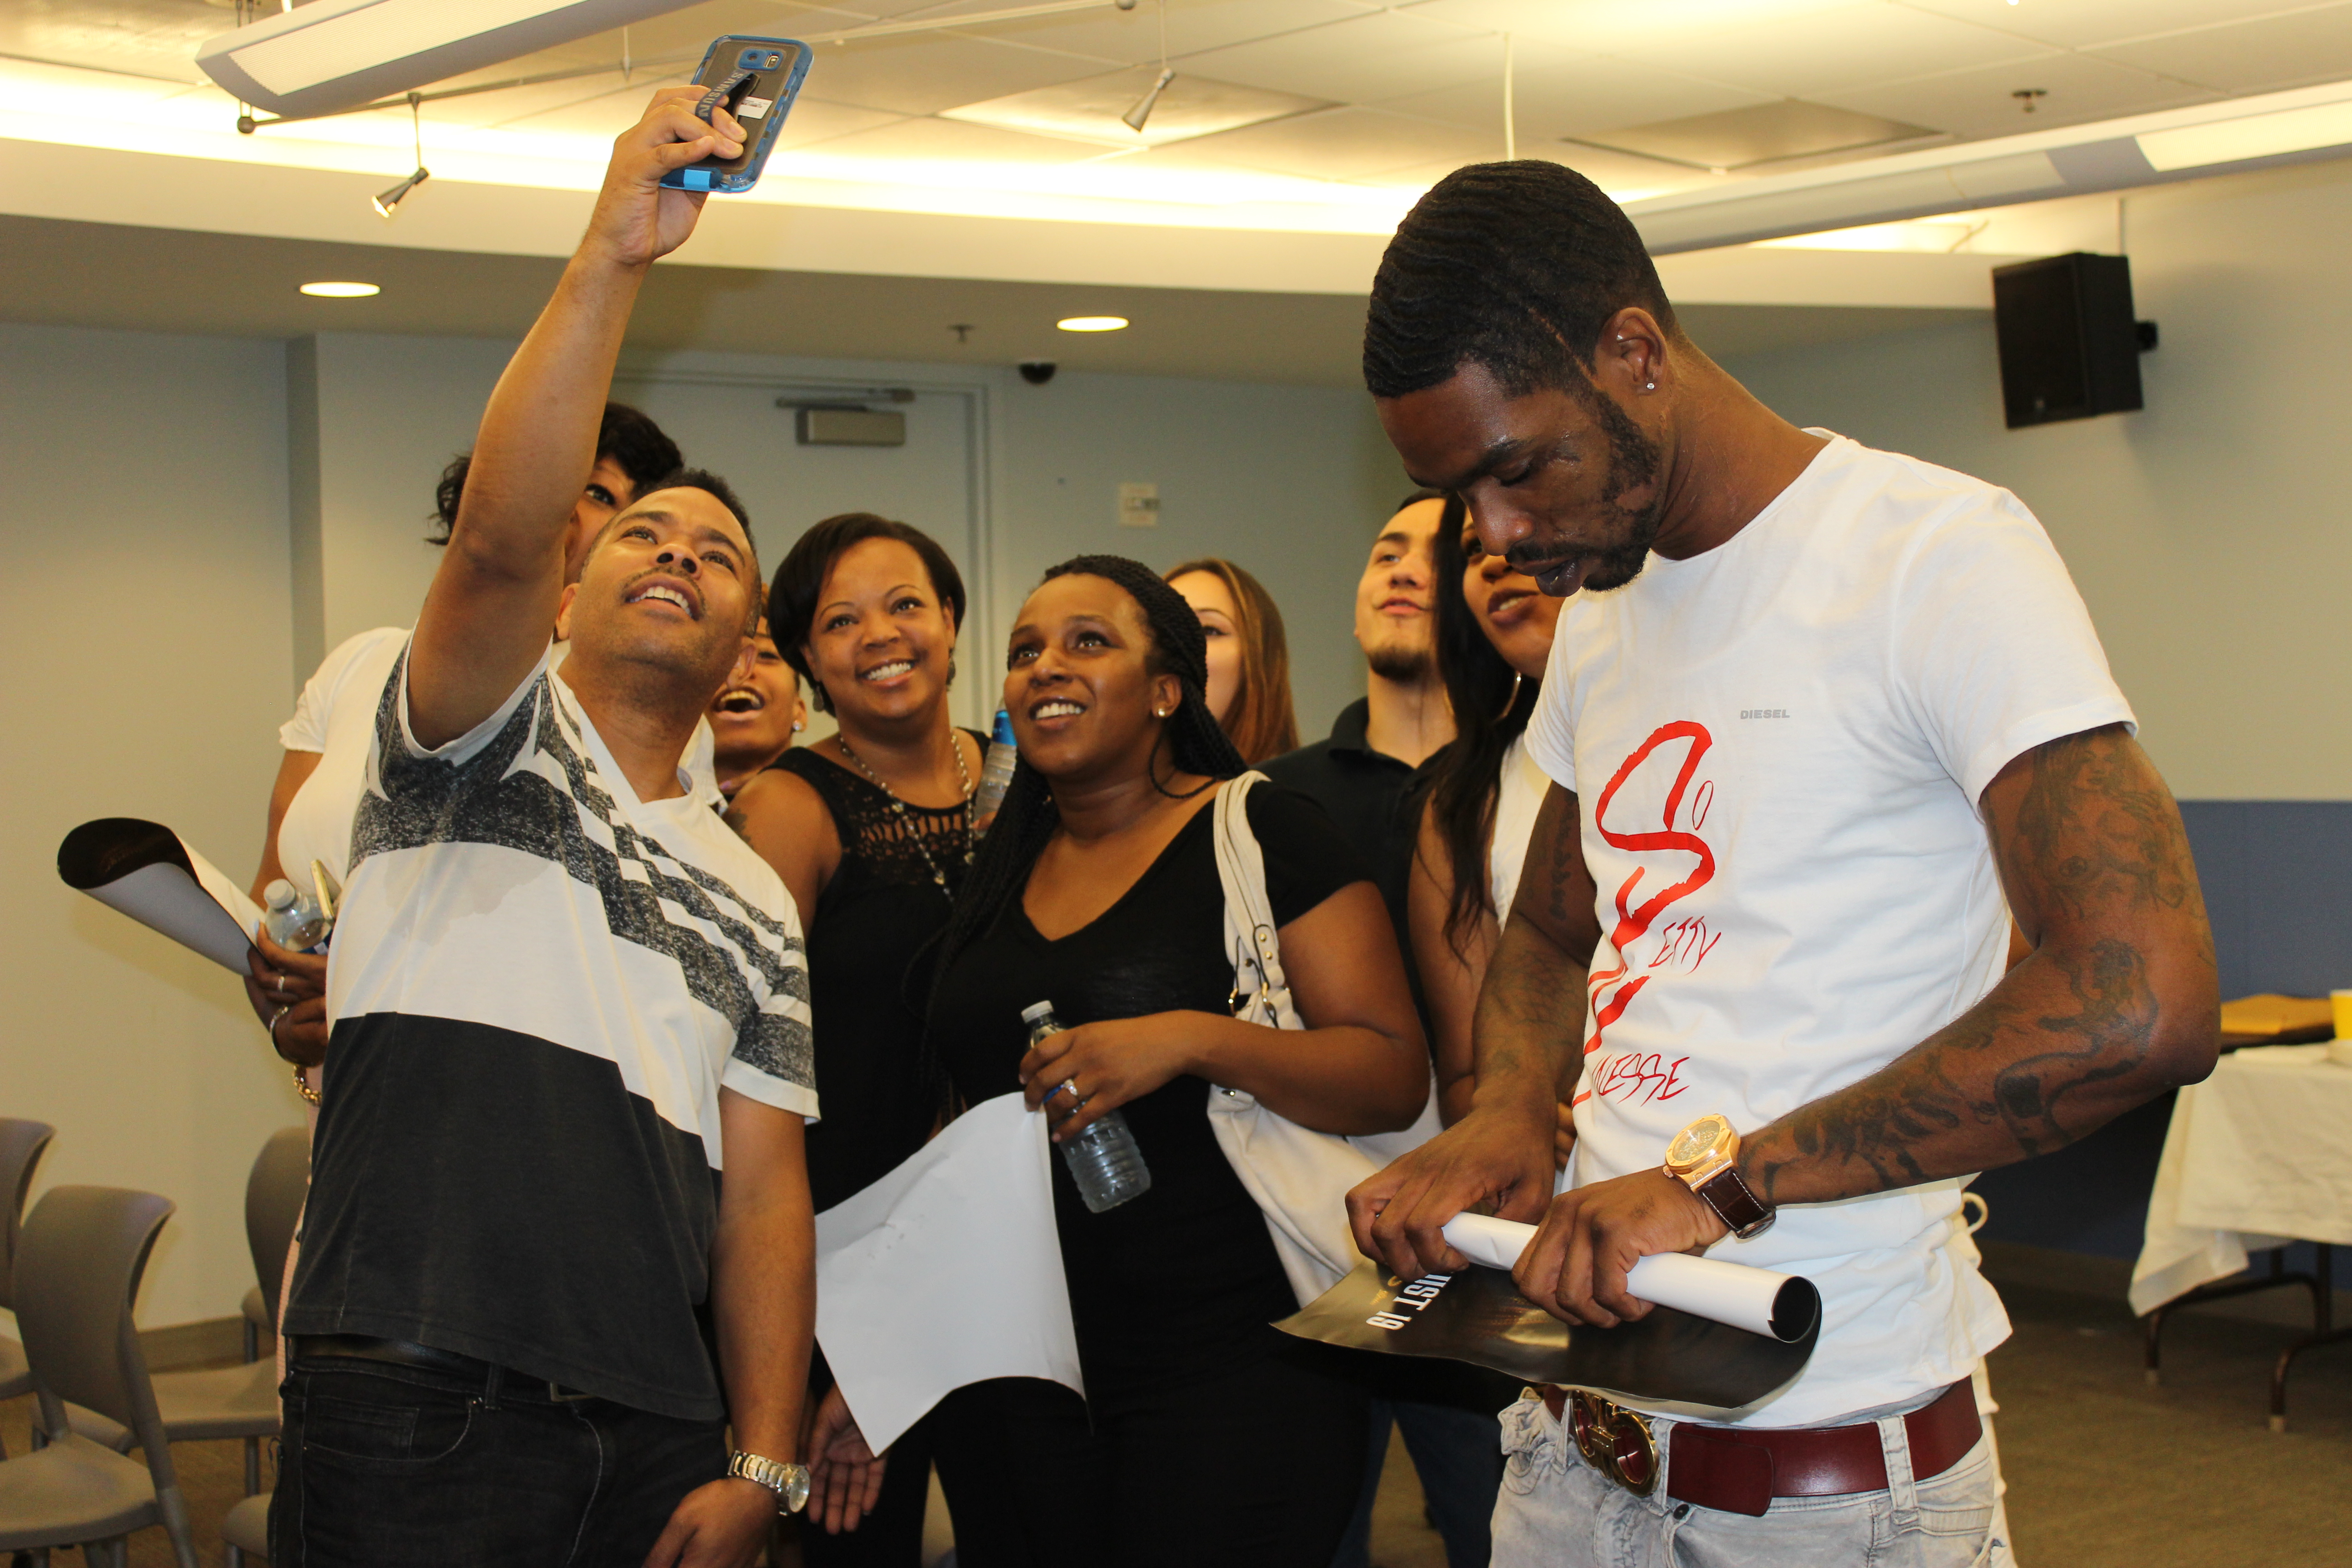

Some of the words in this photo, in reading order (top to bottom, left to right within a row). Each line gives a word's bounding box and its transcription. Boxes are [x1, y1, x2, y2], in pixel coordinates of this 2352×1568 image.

[698, 72, 745, 118] SAMSUN
[1740, 709, 1790, 720] DIESEL
[1366, 1310, 1413, 1331] 19
